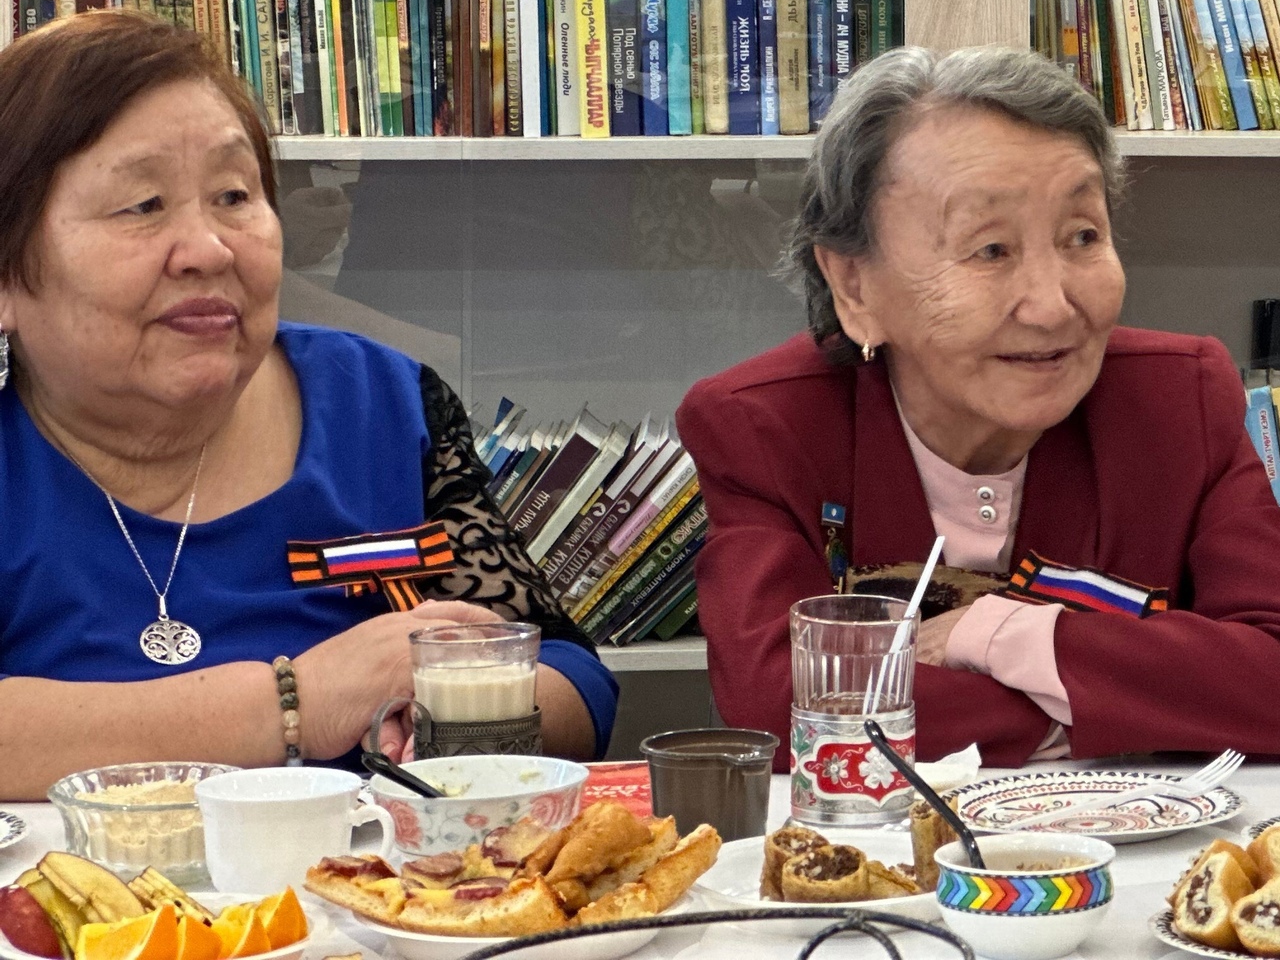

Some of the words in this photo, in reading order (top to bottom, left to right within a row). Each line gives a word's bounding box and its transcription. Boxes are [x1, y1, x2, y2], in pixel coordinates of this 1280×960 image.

[624, 28, 635, 46] Под
[737, 16, 749, 61] ЖИЗНЬ
[836, 24, 849, 35] АЧ
[1220, 23, 1234, 52] Иван
[560, 22, 570, 67] Оленные
[611, 28, 623, 74] Полярной
[835, 39, 849, 73] МУДНА
[625, 49, 635, 78] сенью
[1154, 49, 1166, 91] МАРКОВА
[562, 69, 571, 95] люди
[613, 78, 624, 113] звезды
[1159, 92, 1169, 121] Татьяна
[1265, 454, 1276, 480] ТАПТАЛ
[664, 551, 685, 572] МОРЯ
[682, 546, 690, 554] У
[629, 569, 667, 607] ЛАПТЕВЫХ
